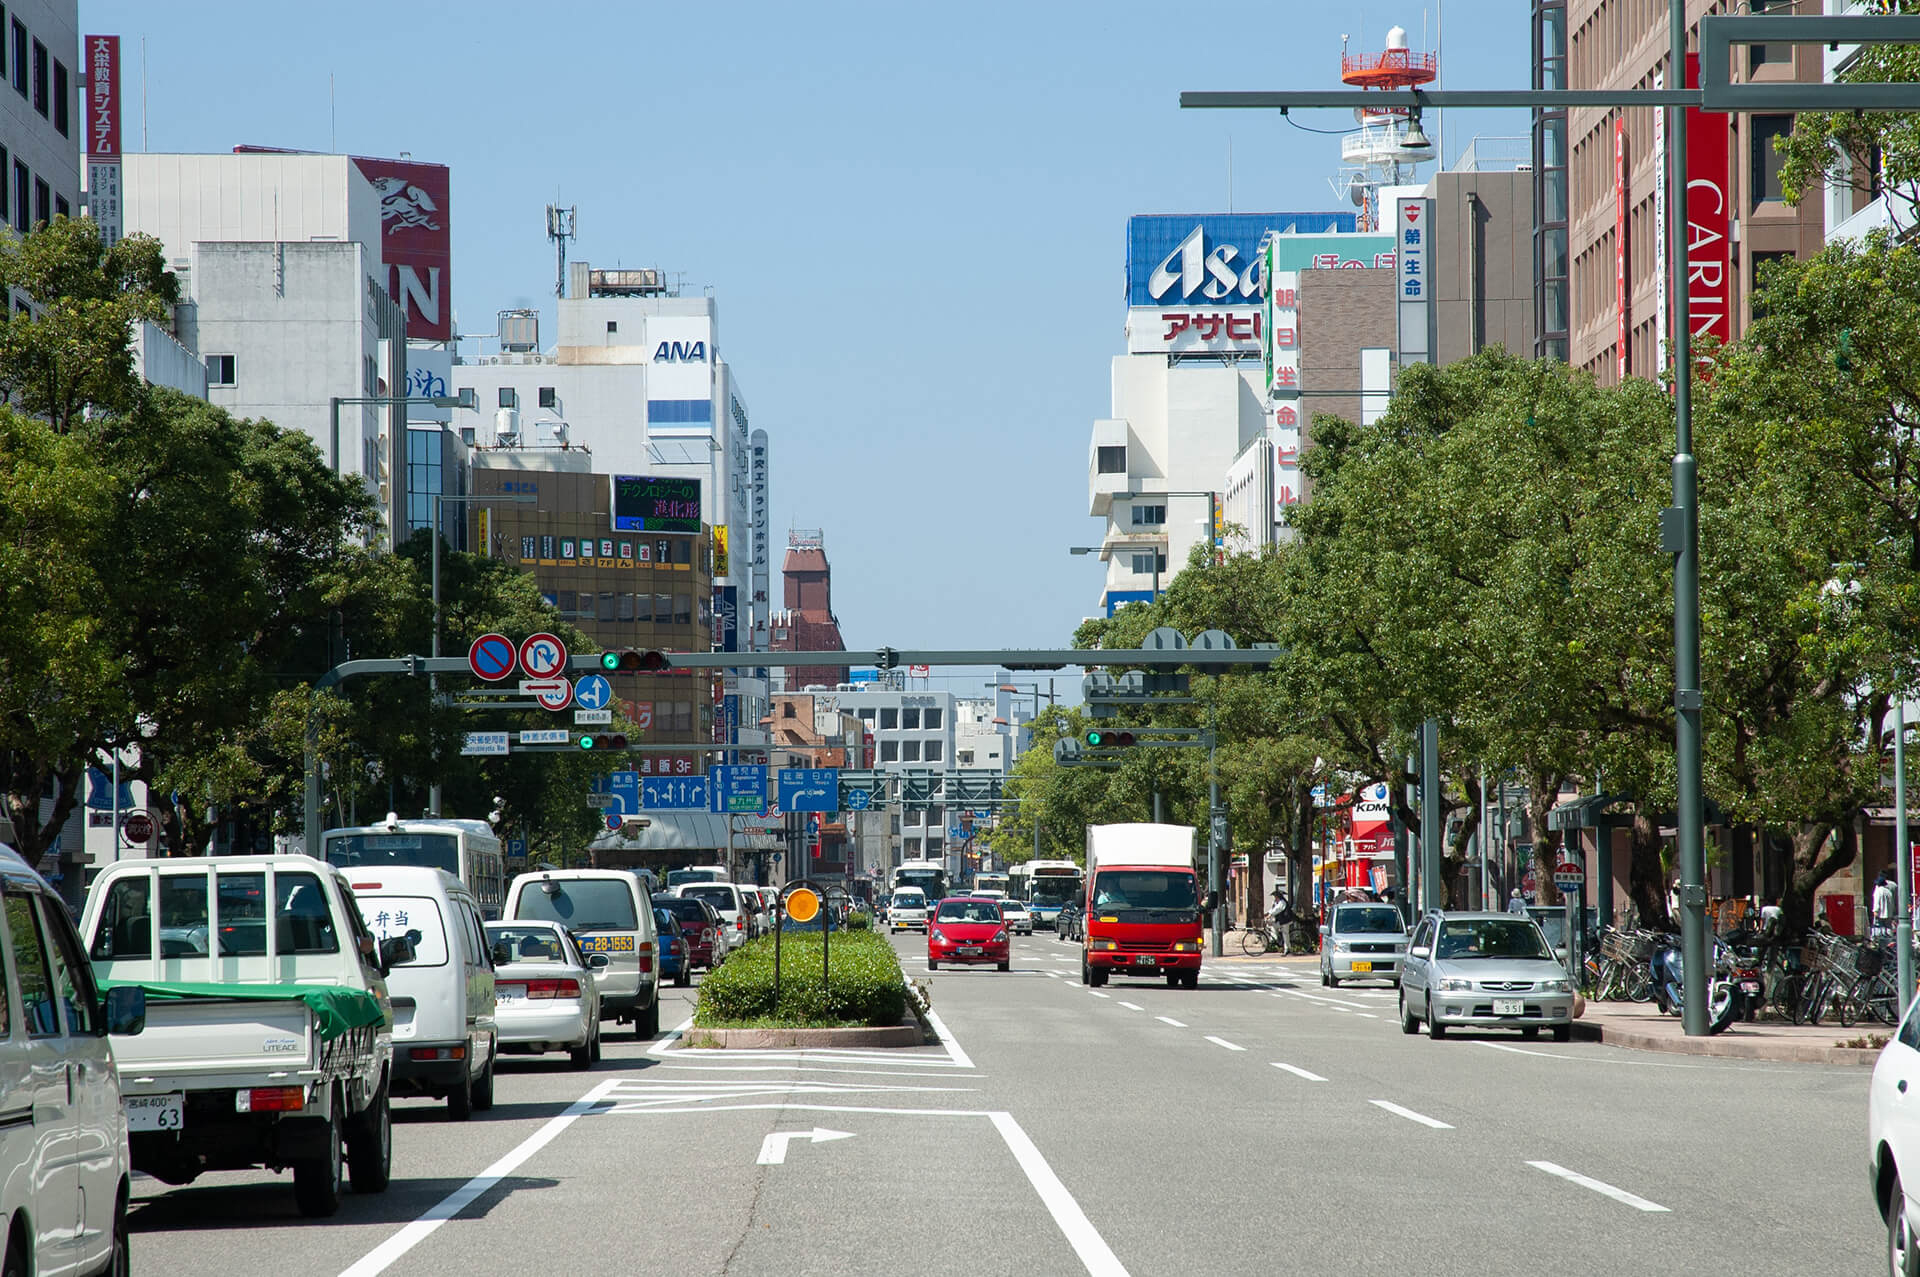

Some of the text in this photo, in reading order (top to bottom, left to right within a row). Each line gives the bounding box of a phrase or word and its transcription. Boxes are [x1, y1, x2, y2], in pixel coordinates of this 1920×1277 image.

[94, 38, 111, 153] 大栄教育システム
[1404, 228, 1421, 296] 第一生命
[653, 340, 706, 362] ANA
[1275, 288, 1297, 505] 朝日生命ビル
[620, 483, 695, 499] テクノロジーの
[722, 600, 736, 631] ANA
[676, 759, 692, 773] 3F
[511, 841, 522, 856] P
[263, 1043, 298, 1053] LITEACE
[128, 1097, 167, 1109] 宮崎 400
[157, 1108, 180, 1127] 63
